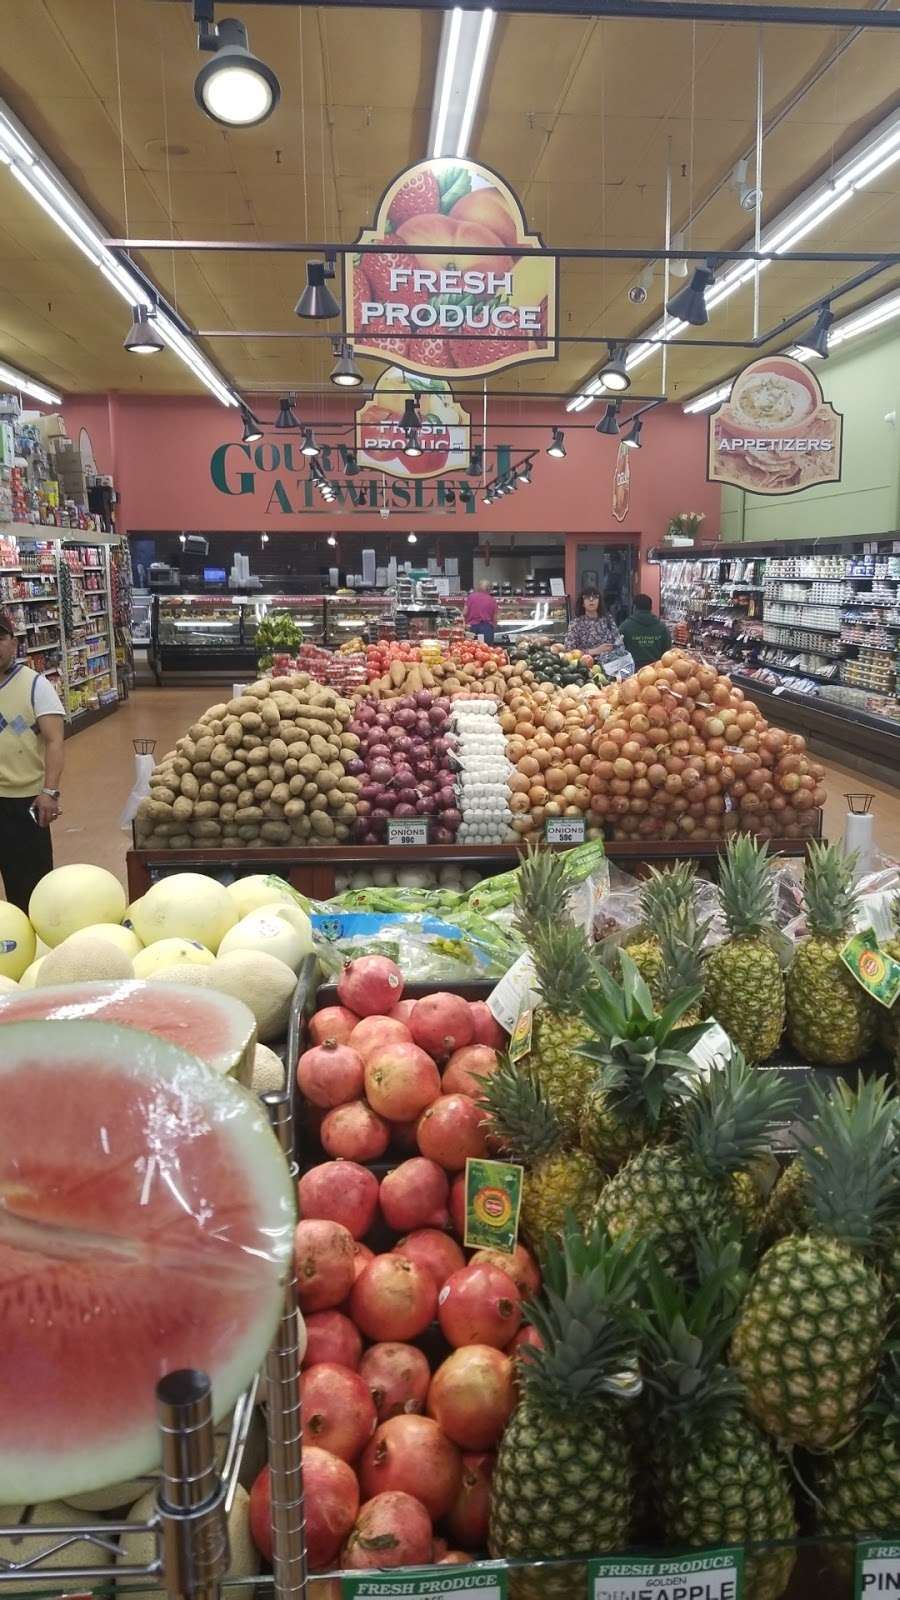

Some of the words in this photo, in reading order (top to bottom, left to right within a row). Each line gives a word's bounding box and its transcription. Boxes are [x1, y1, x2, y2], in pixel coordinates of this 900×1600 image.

[389, 269, 513, 295] FRESH
[361, 302, 542, 329] PRODUCE
[380, 420, 447, 434] FRSH
[364, 438, 464, 455] PROUCE
[718, 438, 833, 451] APPETIZERS
[332, 479, 483, 513] WESLEY
[390, 828, 425, 836] ONIONS
[598, 1564, 655, 1576] FRESH
[658, 1555, 734, 1575] PRODUCE
[357, 1582, 415, 1595] FRESH
[419, 1574, 498, 1593] PRODUCE
[646, 1576, 687, 1587] GOLDEN
[862, 1572, 900, 1591] PIN
